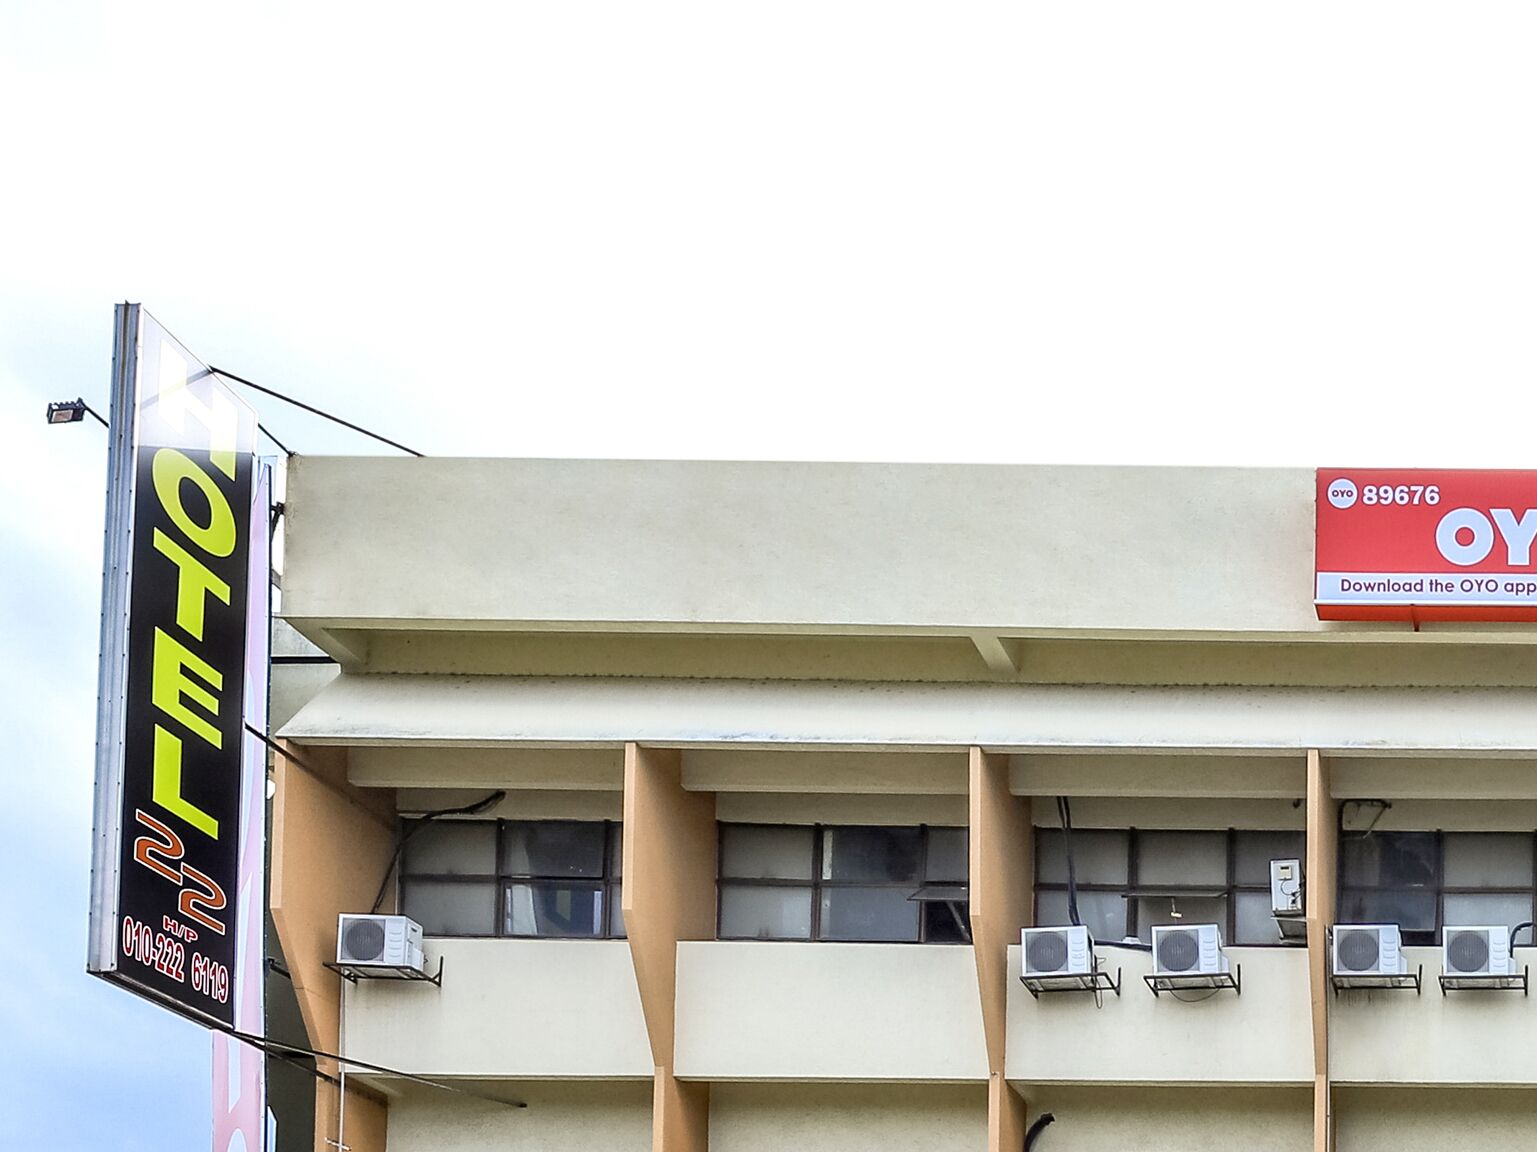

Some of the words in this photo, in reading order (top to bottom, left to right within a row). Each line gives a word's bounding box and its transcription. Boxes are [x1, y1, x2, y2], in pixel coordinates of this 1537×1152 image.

[1331, 489, 1354, 498] OYO
[1362, 485, 1440, 505] 89676
[1340, 579, 1424, 593] Download
[1429, 579, 1455, 593] the
[1460, 579, 1498, 593] OYO
[1504, 582, 1537, 596] app
[134, 808, 227, 936] 22
[163, 914, 198, 943] H/P
[122, 915, 185, 983] 010-222
[191, 951, 229, 1004] 6119
